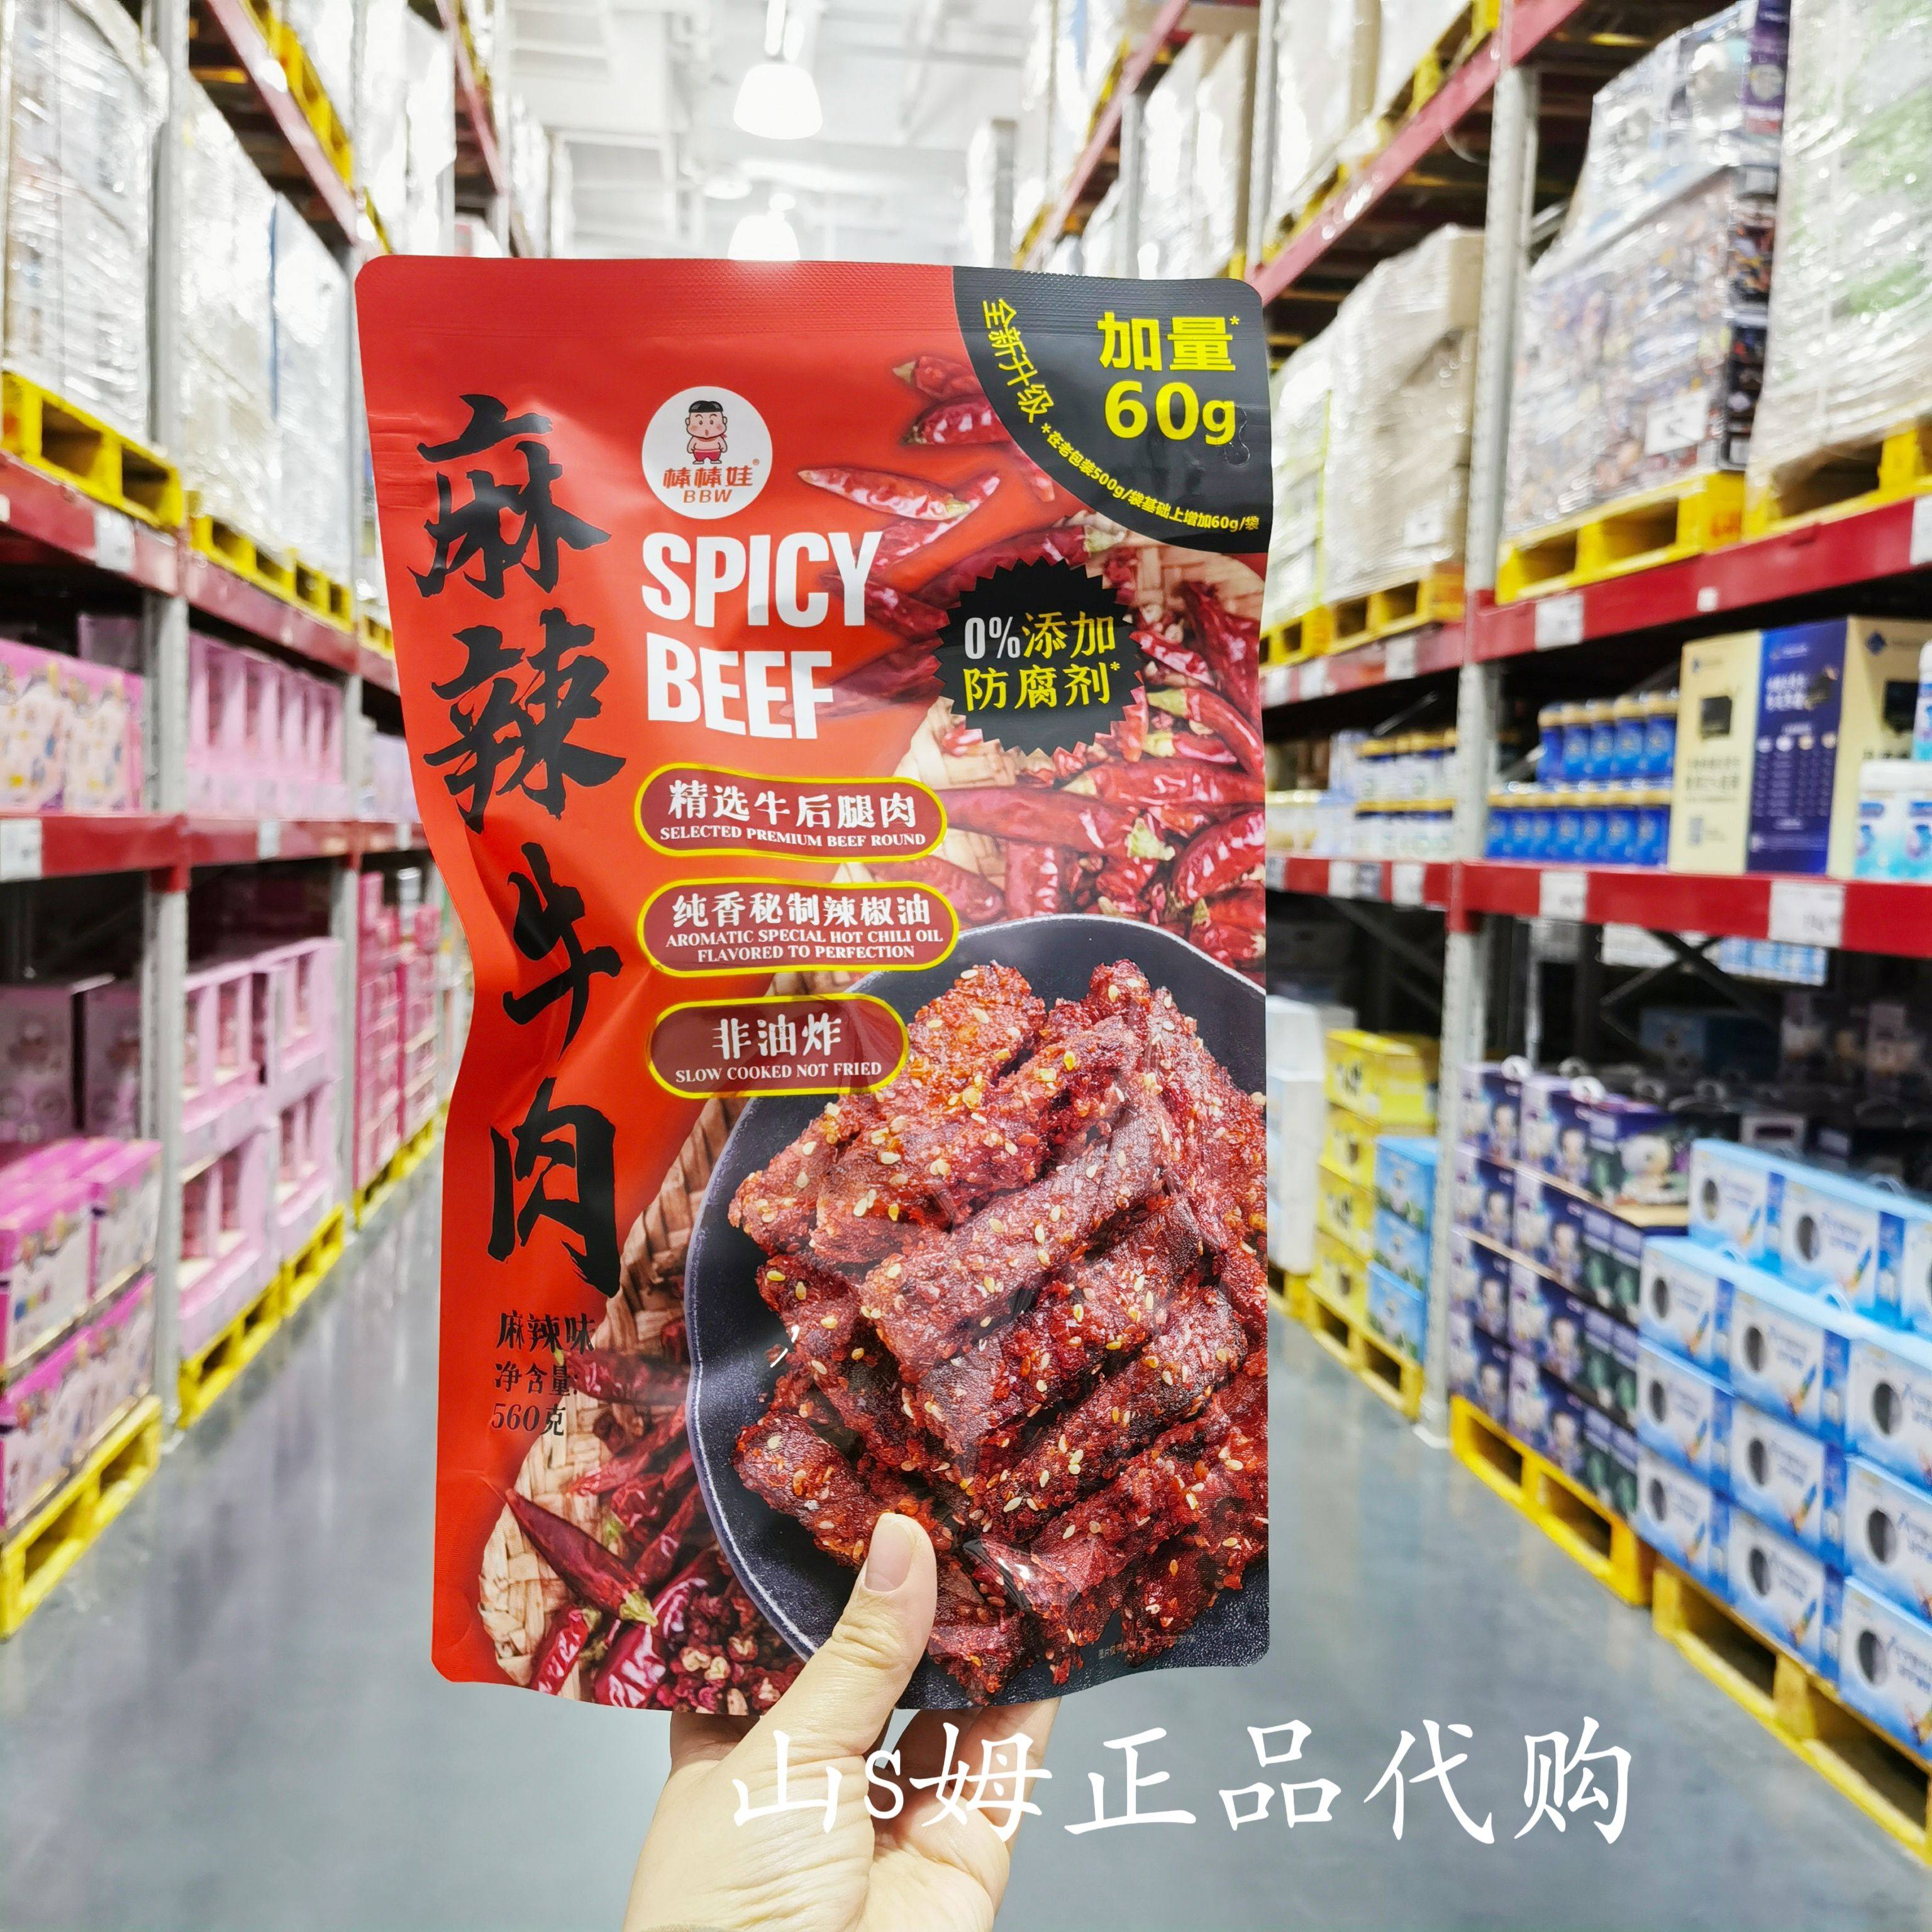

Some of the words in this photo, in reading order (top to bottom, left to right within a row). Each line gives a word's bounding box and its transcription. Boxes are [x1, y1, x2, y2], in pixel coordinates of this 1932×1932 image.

[982, 299, 1054, 423] 全新升级
[1104, 381, 1236, 445] 60g
[663, 465, 753, 489] 棒棒娃
[683, 489, 733, 503] BBW
[642, 532, 883, 628] SPICY
[964, 611, 1116, 659] 0%添加
[647, 632, 834, 739] BEEF
[668, 779, 916, 828] 精选牛后腿肉
[407, 394, 626, 1298] 麻辣牛肉
[660, 825, 741, 840] SELECTED
[747, 828, 822, 847] PREMIUM
[827, 835, 866, 847] BEEF
[871, 833, 925, 846] ROUND
[672, 891, 930, 928] 纯香秘制辣椒油
[665, 930, 753, 947] AROMATIC
[758, 929, 826, 943] SPECIAL
[830, 931, 863, 944] HOT
[867, 930, 911, 943] CHILI
[916, 929, 943, 943] OIL
[697, 945, 783, 962] FLAVORED
[787, 945, 810, 958] TO
[815, 945, 915, 958] PERFECTION
[712, 1013, 841, 1060] 非油炸
[675, 1068, 722, 1083] SLOW
[727, 1065, 792, 1080] COOKED
[796, 1064, 829, 1077] NOT
[833, 1062, 882, 1076] FRIED
[496, 1309, 595, 1354] 麻辣味
[491, 1403, 566, 1436] 560克
